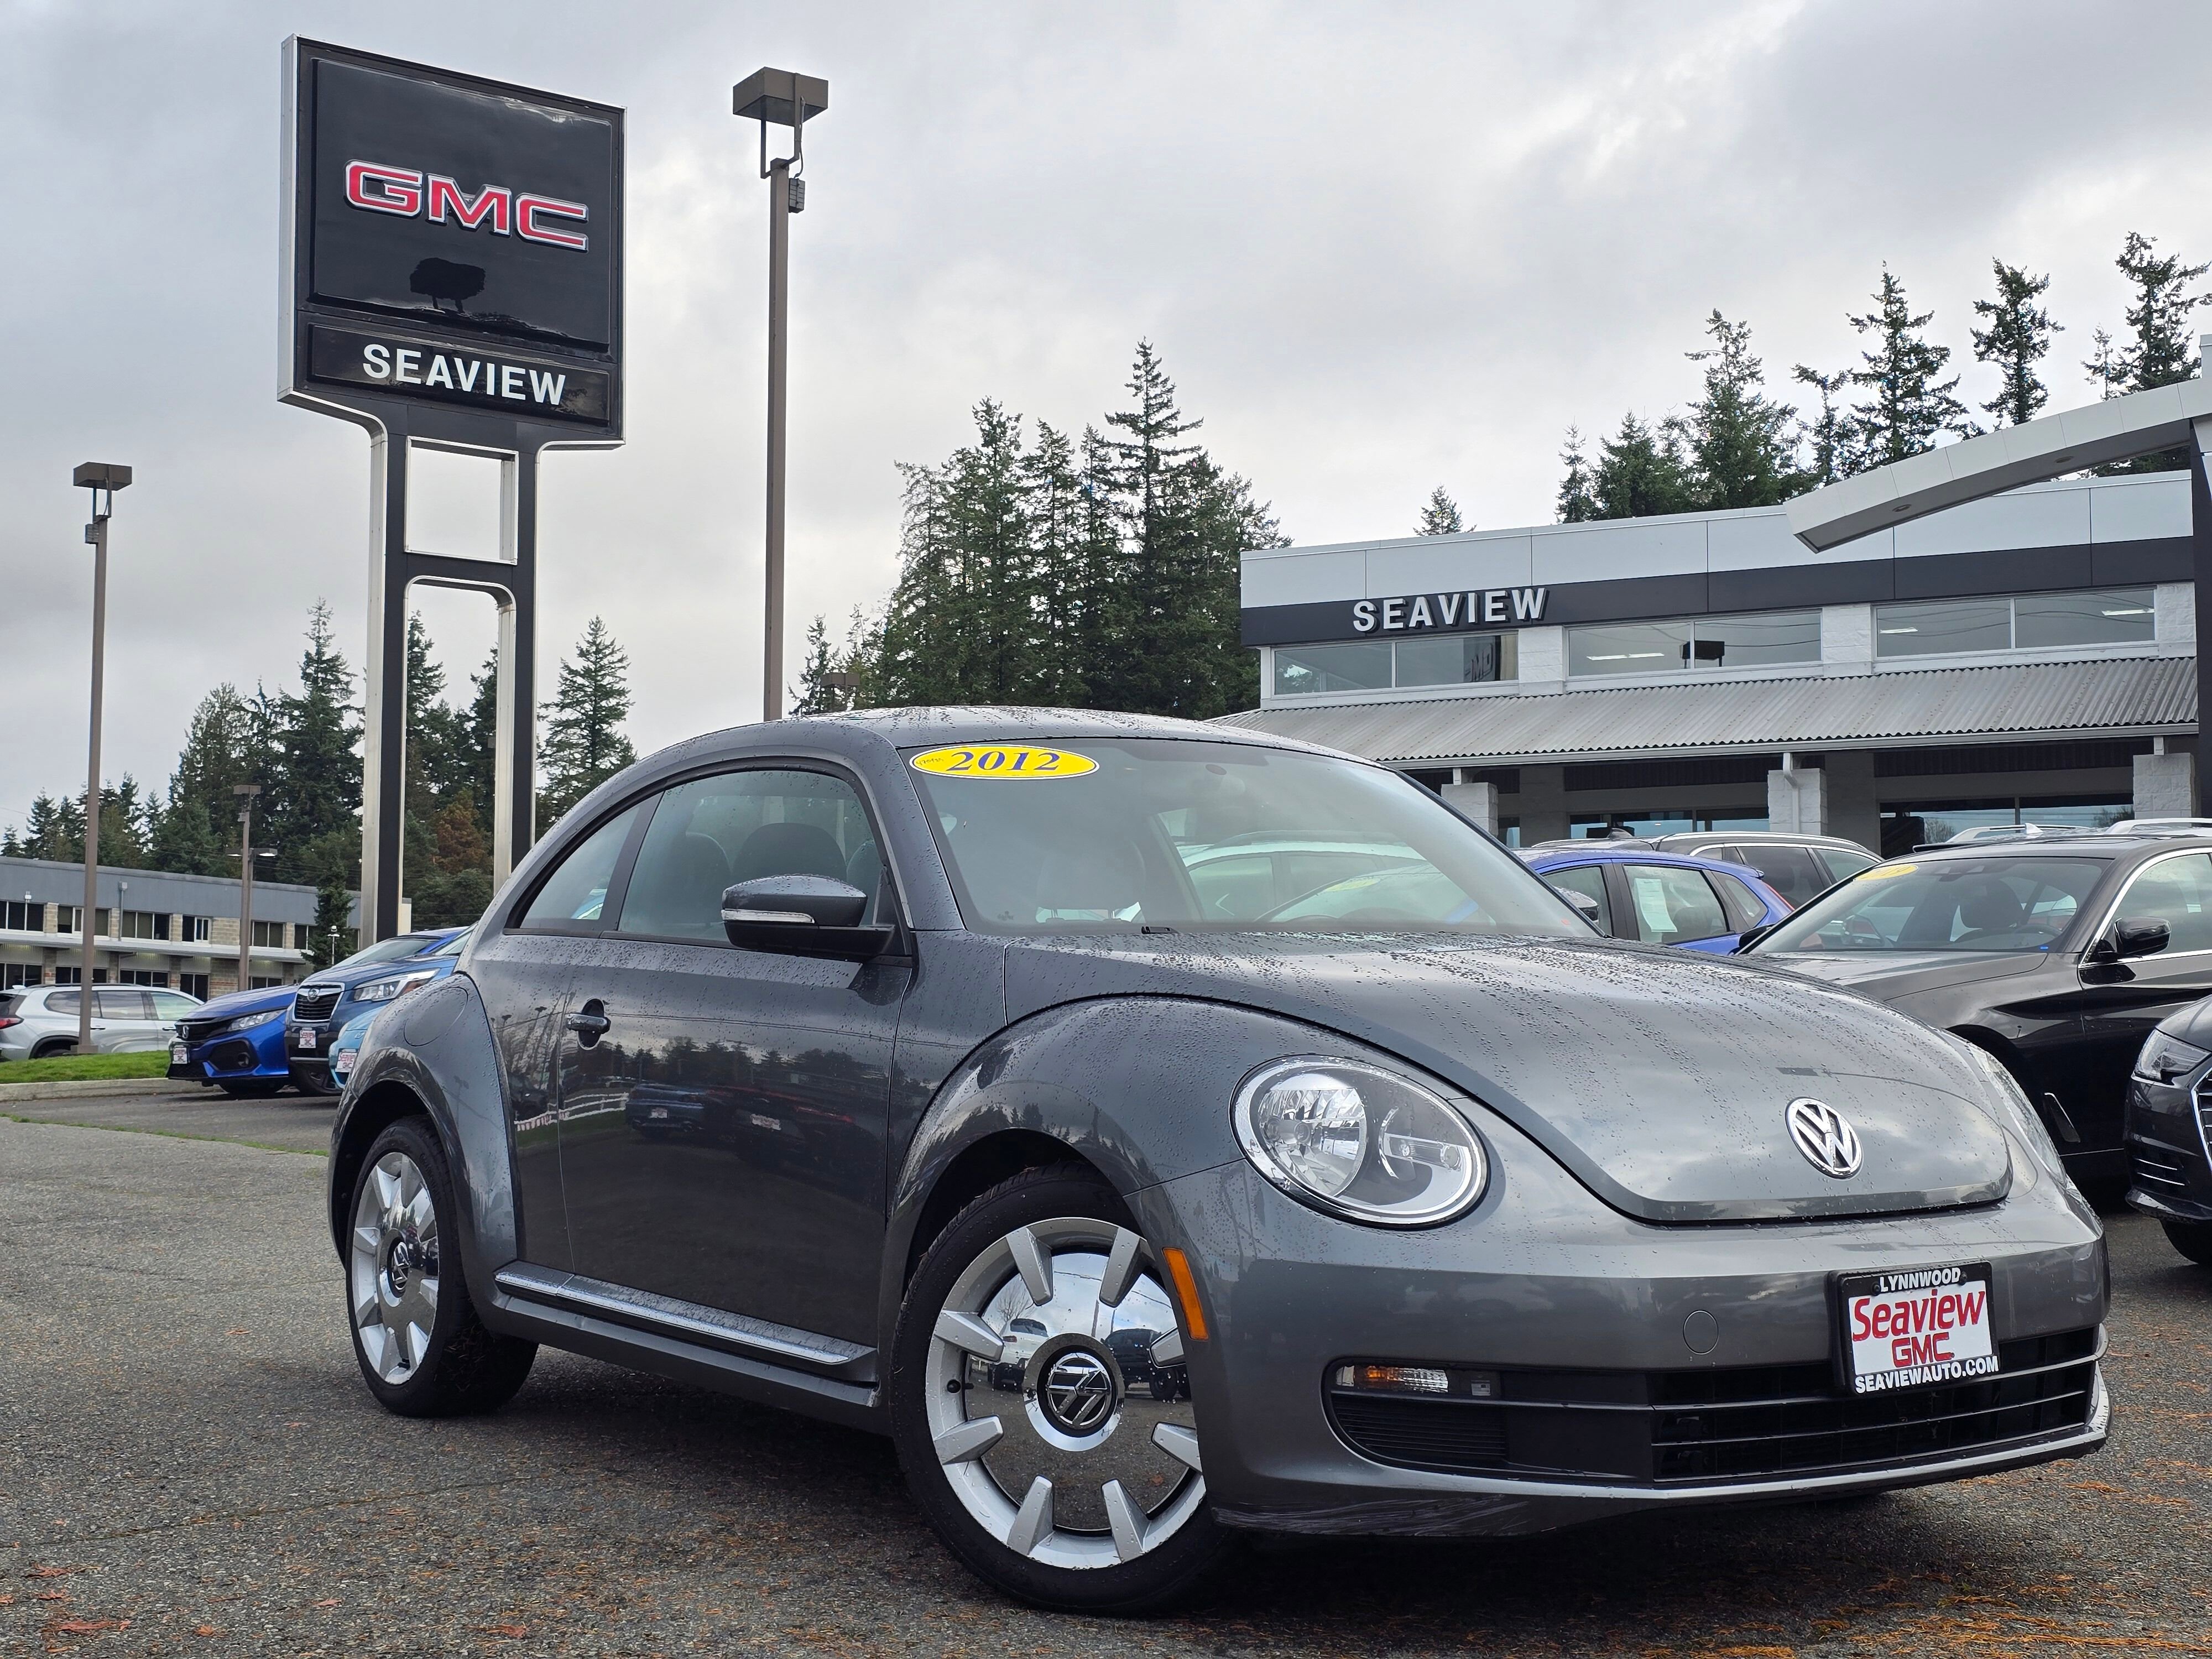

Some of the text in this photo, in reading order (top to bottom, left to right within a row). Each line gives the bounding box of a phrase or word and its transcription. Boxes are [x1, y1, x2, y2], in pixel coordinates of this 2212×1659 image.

[345, 159, 588, 252] GMC
[362, 344, 565, 405] SEAVIEW
[1353, 587, 1548, 632] SEAVIEW
[946, 751, 1060, 771] 2012
[1880, 1267, 1961, 1292] LYNNWOOD
[1853, 1289, 1985, 1342] Seaview
[1892, 1332, 1955, 1368] GMC
[1855, 1355, 1999, 1394] SEAVIEWAUTO.COM
